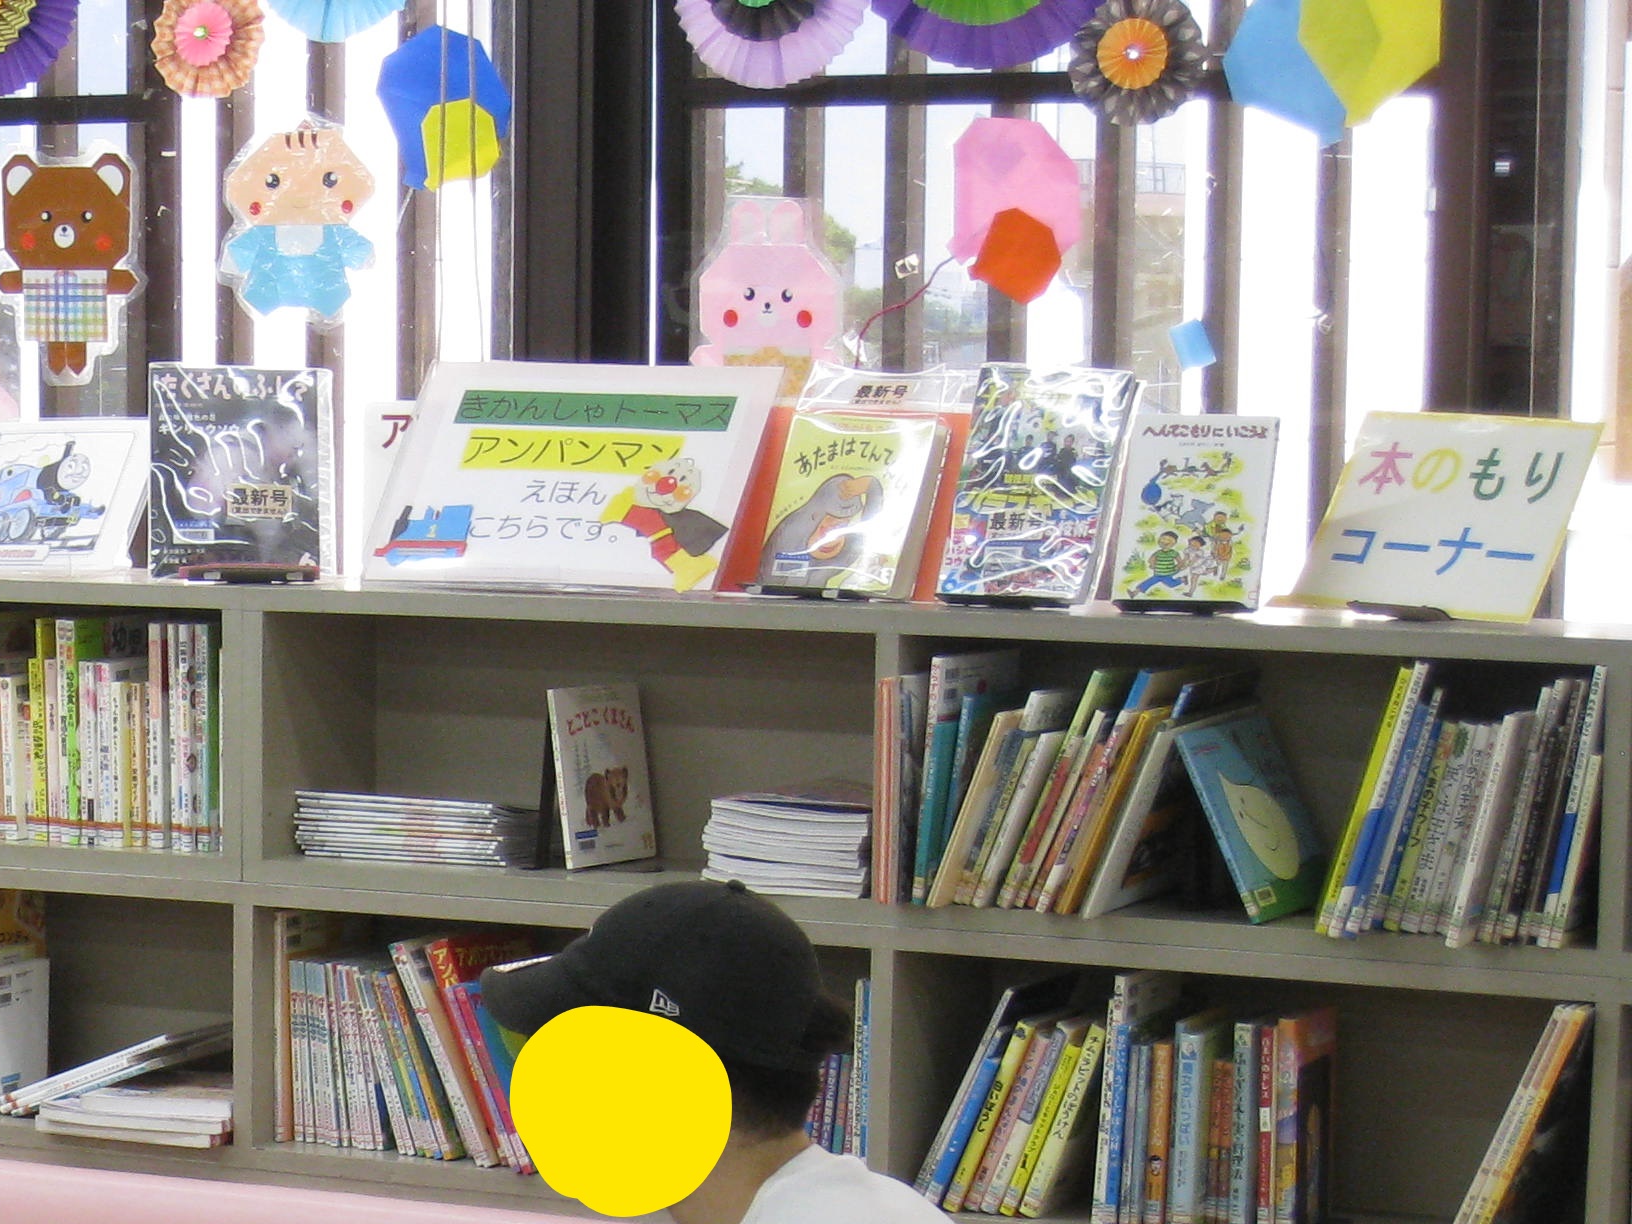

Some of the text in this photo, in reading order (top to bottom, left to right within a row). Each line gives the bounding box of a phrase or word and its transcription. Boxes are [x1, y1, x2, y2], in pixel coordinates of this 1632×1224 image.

[854, 384, 908, 399] 最新号
[459, 395, 730, 427] きかんしゃトーマス
[1142, 424, 1268, 439] へんてこもりにいこうよ
[463, 435, 681, 469] アンパンマン
[1358, 441, 1566, 503] 本のもり
[231, 488, 288, 507] 最新号
[520, 479, 607, 506] えほん
[469, 515, 618, 544] こちらです。
[1331, 526, 1537, 575] コーナー
